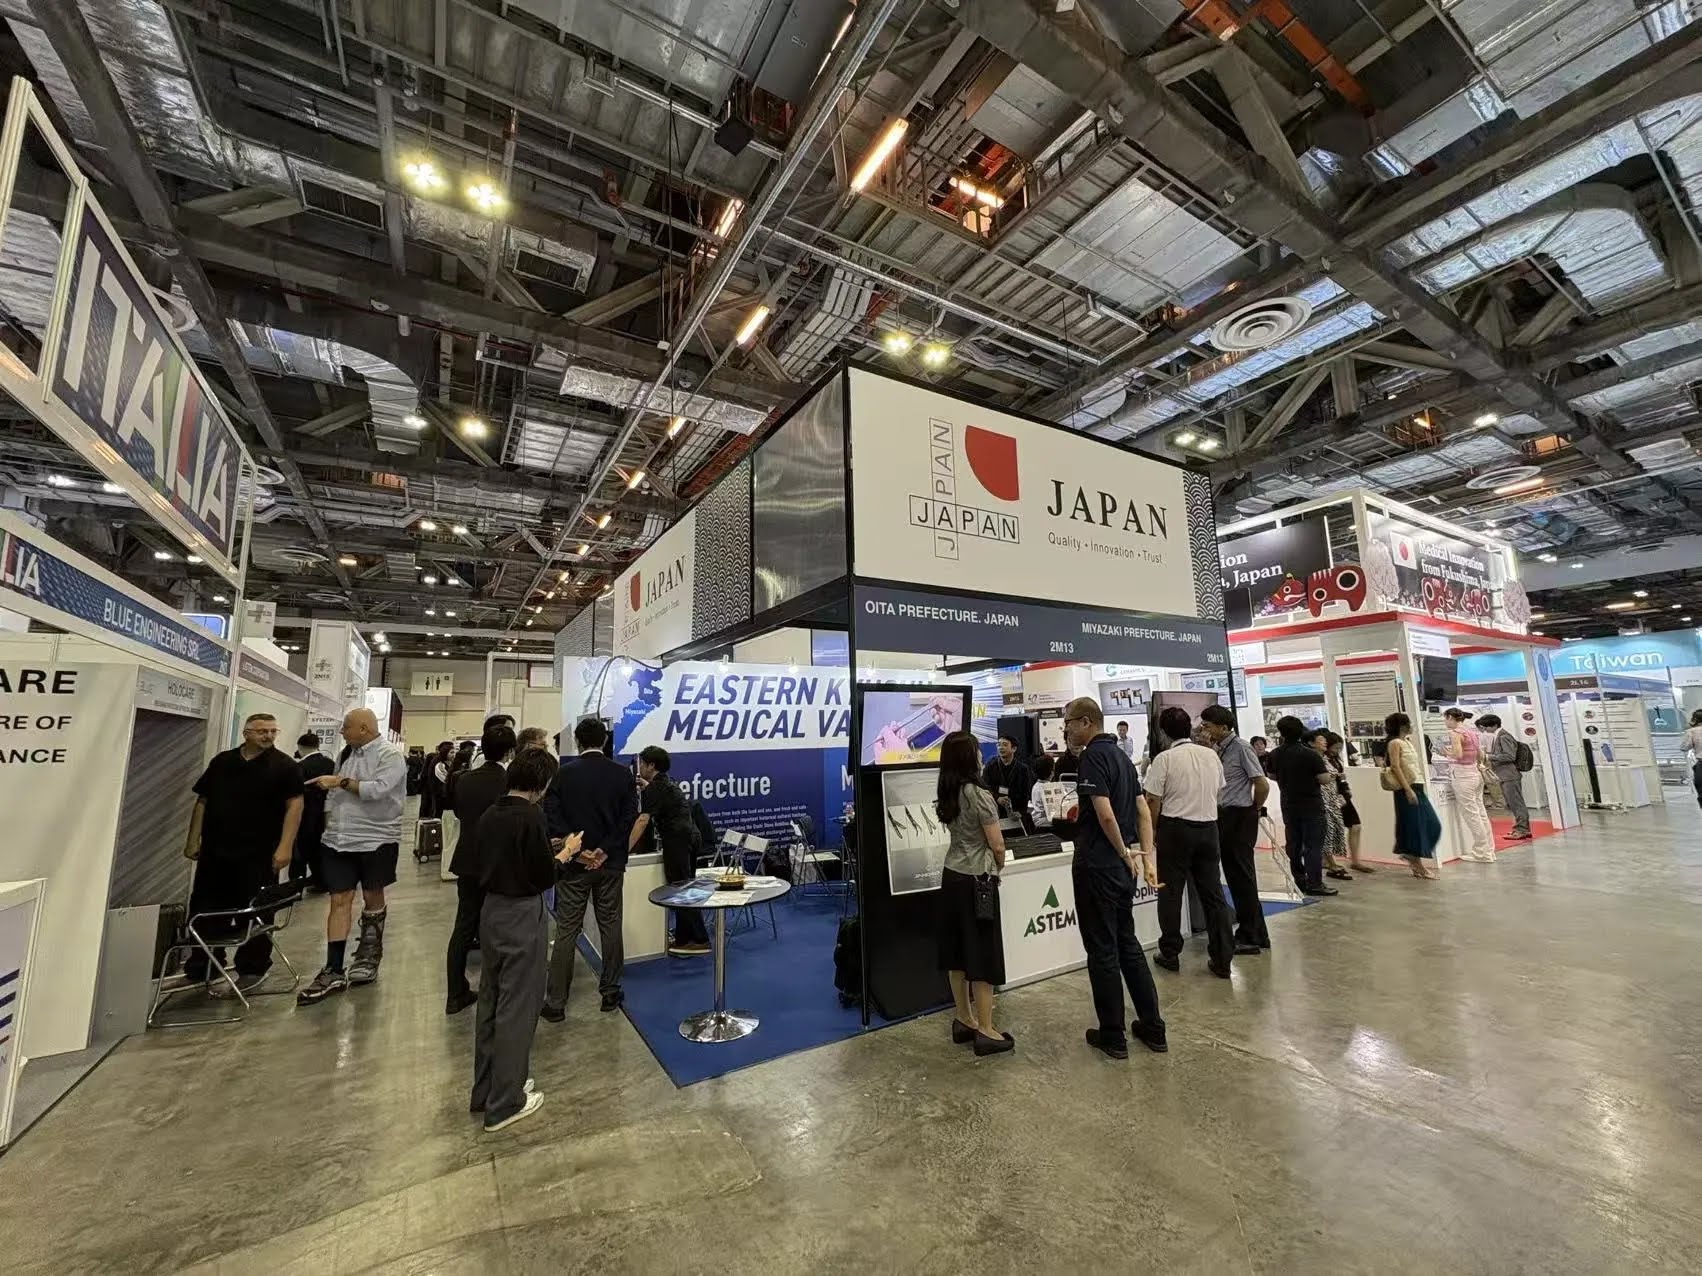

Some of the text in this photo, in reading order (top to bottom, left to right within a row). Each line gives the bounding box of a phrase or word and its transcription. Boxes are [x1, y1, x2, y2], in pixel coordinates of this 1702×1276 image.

[62, 234, 228, 540] ITALIA
[916, 501, 1017, 540] JAPAN
[1047, 478, 1168, 540] JAPAN
[1048, 531, 1163, 564] Quality Innovation Trust
[645, 555, 687, 608] JAPAN
[1233, 564, 1284, 588] Japan
[103, 597, 133, 631] BLUE
[133, 611, 188, 656] ENGINEERING
[865, 600, 897, 616] OITA
[983, 611, 1020, 628] JAPAN
[1049, 640, 1075, 654] 2M13
[1081, 622, 1123, 637] MIYAZAKI
[1177, 632, 1202, 644] JAPAN
[1206, 652, 1225, 664] 2M13
[1568, 650, 1664, 671] Taiwan
[674, 673, 817, 706] EASTERN
[36, 715, 73, 730] OF
[664, 709, 806, 742] MEDICAL
[678, 773, 772, 801] efecture
[1024, 908, 1077, 938] ASTEM
